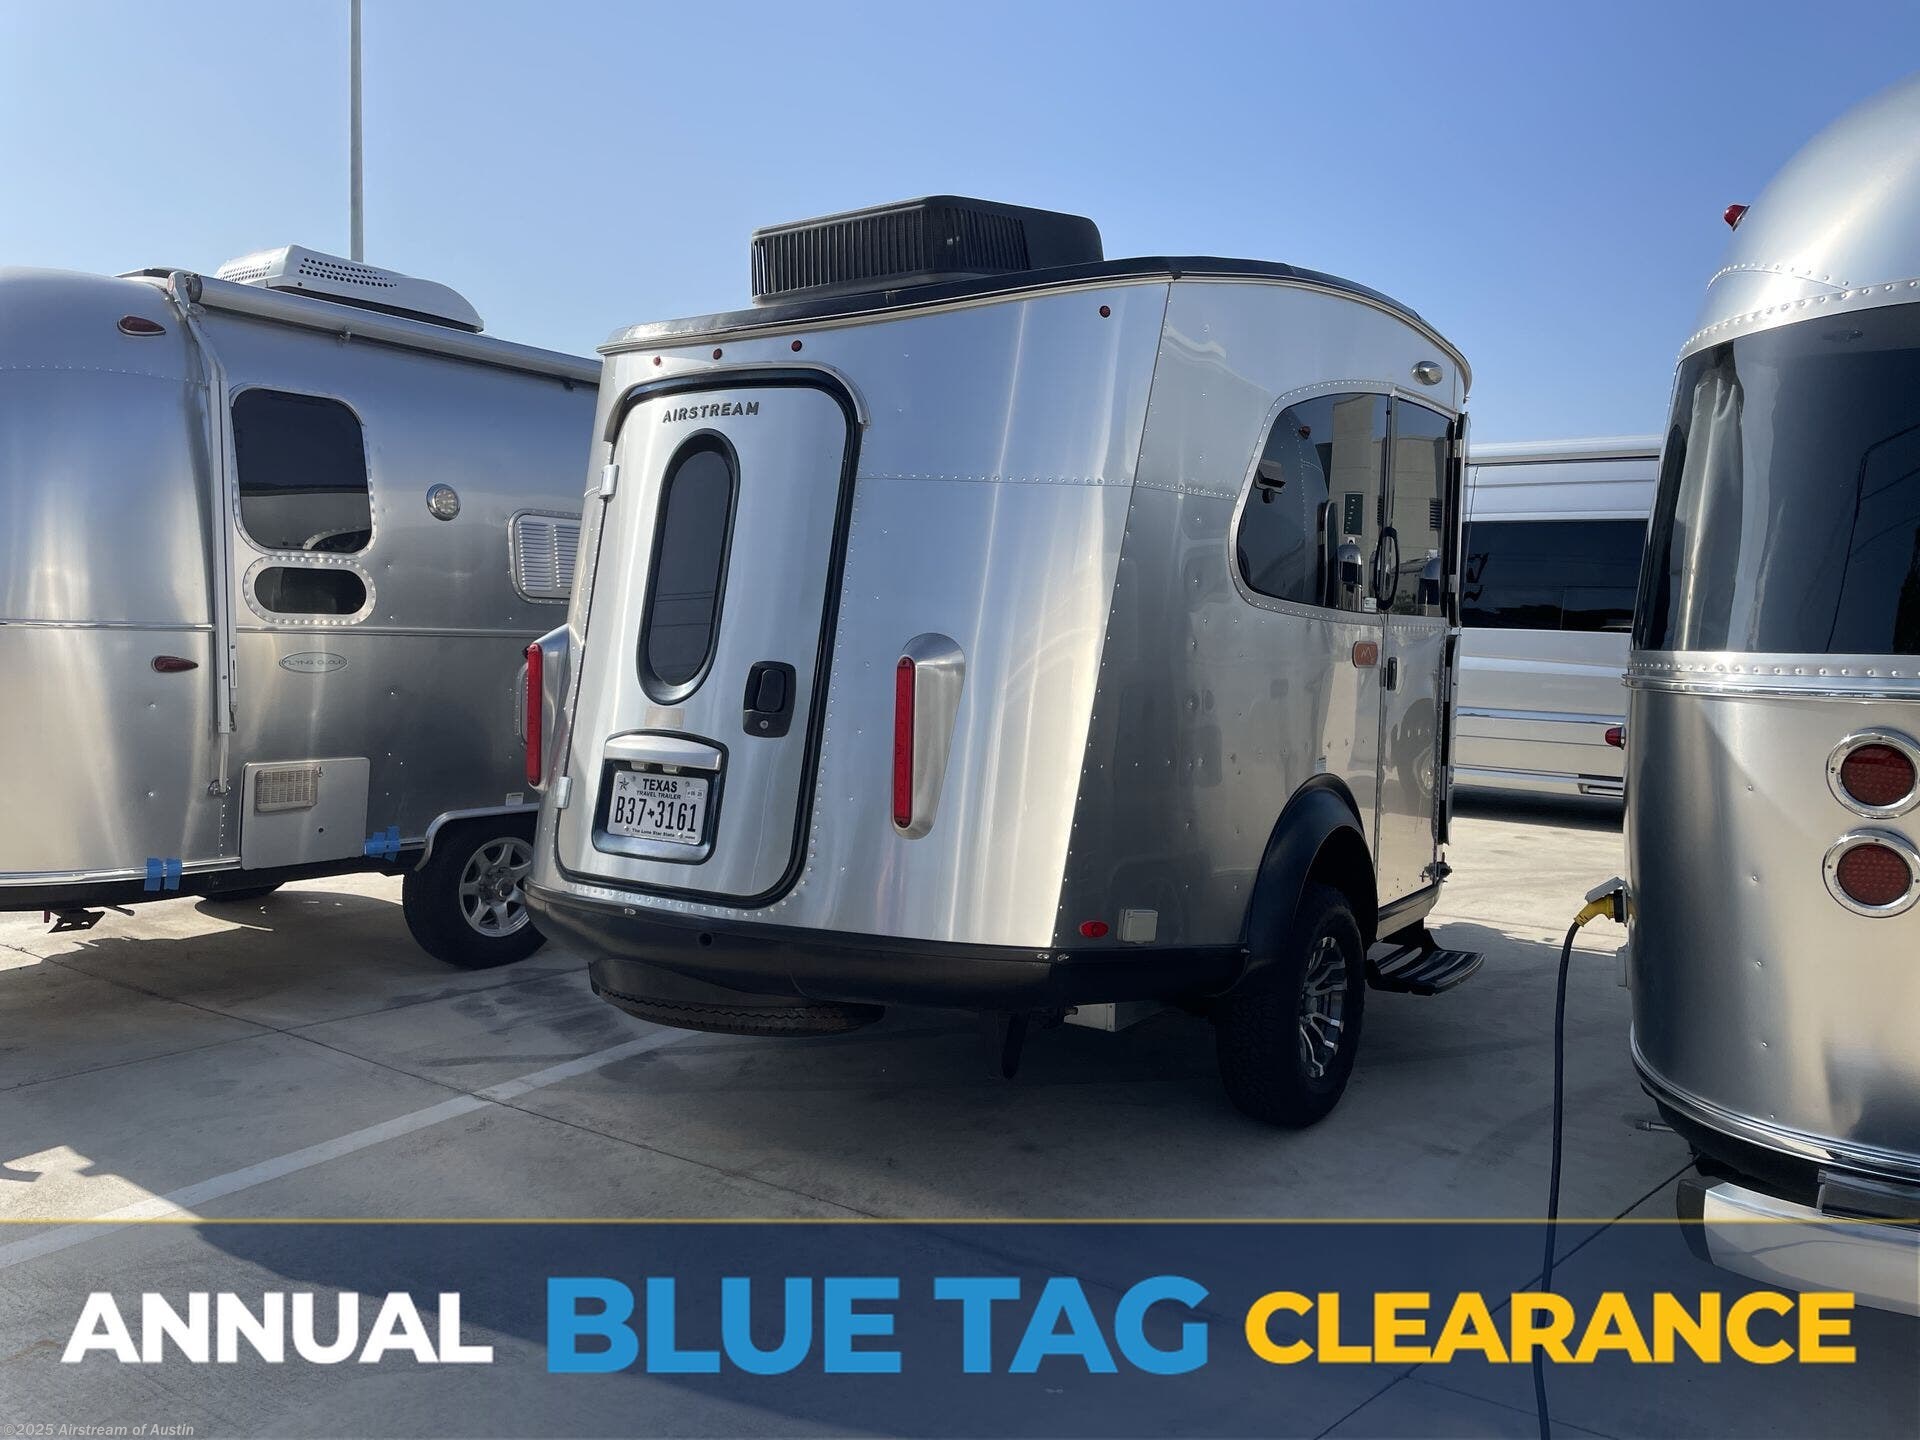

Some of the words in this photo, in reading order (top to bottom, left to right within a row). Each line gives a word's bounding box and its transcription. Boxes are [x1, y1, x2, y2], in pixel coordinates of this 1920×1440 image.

[662, 401, 760, 423] AIRSTREAM
[642, 778, 678, 793] TEXAS
[636, 790, 657, 798] TRAVEL
[658, 792, 682, 800] TRAILER
